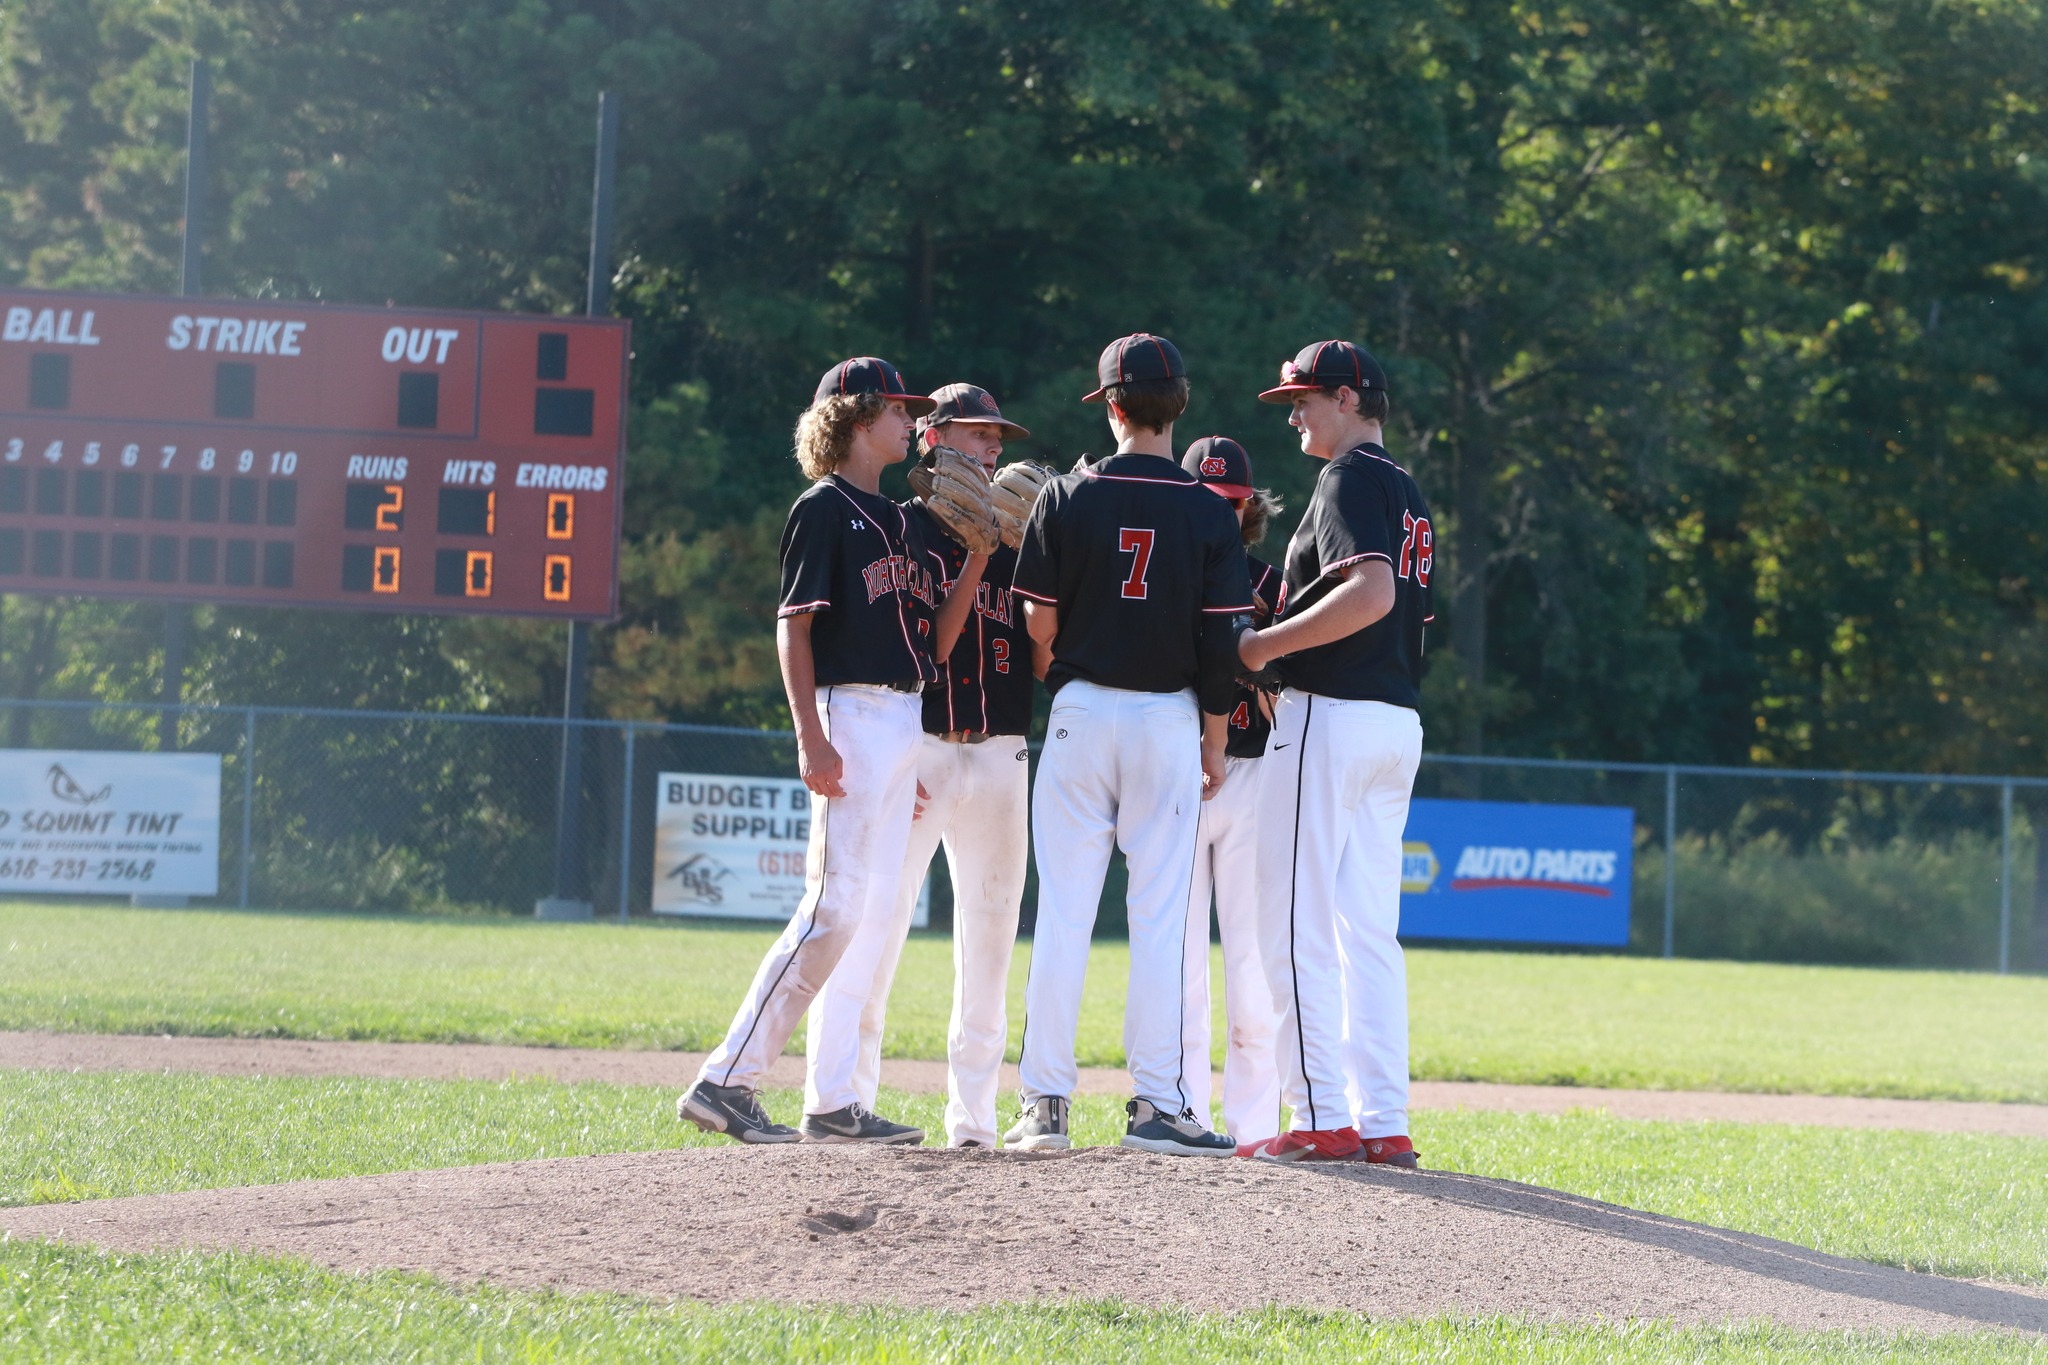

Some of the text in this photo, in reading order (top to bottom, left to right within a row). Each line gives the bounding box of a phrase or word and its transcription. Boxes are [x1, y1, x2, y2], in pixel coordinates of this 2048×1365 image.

[2, 306, 101, 345] BALL
[167, 315, 306, 356] STRIKE
[381, 326, 458, 364] OUT
[5, 438, 297, 475] 3 4 5 6 7 8 9 10
[347, 455, 408, 481] RUNS
[443, 460, 496, 486] HITS
[515, 463, 608, 491] ERRORS
[375, 485, 575, 540] 2 1 0
[1119, 527, 1155, 600] 7
[1398, 508, 1433, 588] 28
[373, 546, 572, 602] 0 0 0
[862, 555, 908, 604] NORTH
[974, 581, 1014, 630] CLAY
[992, 638, 1010, 674] 2
[1230, 701, 1249, 730] 4
[667, 781, 780, 809] BUDGET
[21, 810, 116, 834] SQUINT
[125, 811, 184, 835] TINT
[692, 813, 811, 840] SUPPLIE
[757, 850, 806, 878] (618
[1454, 845, 1532, 880] AUTO
[1531, 848, 1618, 883] PARTS
